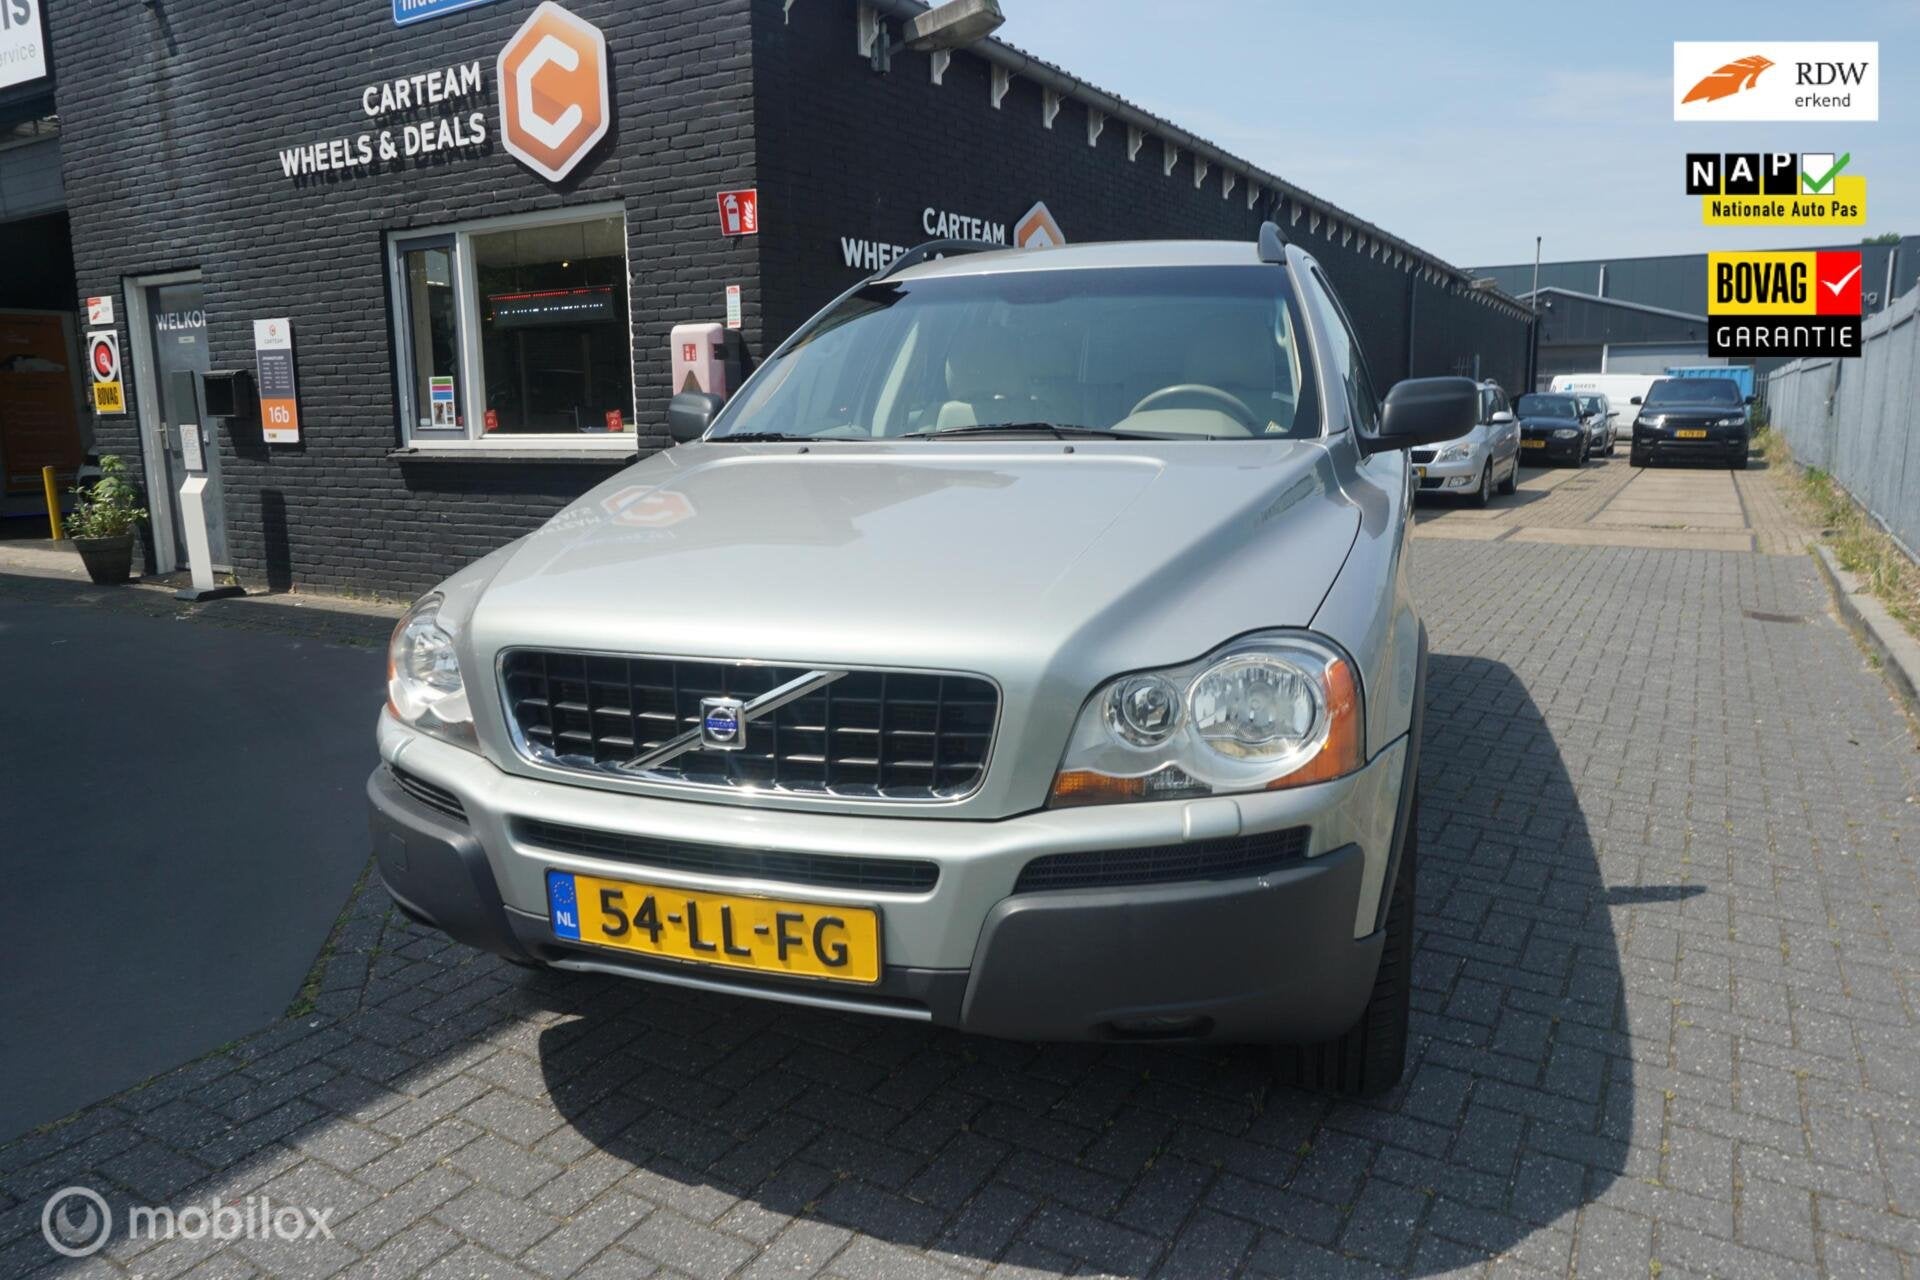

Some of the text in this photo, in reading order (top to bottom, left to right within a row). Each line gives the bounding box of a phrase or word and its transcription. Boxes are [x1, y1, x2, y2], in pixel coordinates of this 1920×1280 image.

[362, 61, 481, 117] CARTEAM
[279, 112, 486, 178] WHEELS & DEALS
[922, 206, 1005, 246] CARTEAM
[96, 386, 119, 406] BOVAG
[268, 404, 290, 423] 16b
[556, 910, 577, 928] NL
[600, 887, 849, 968] 54-LL-FG
